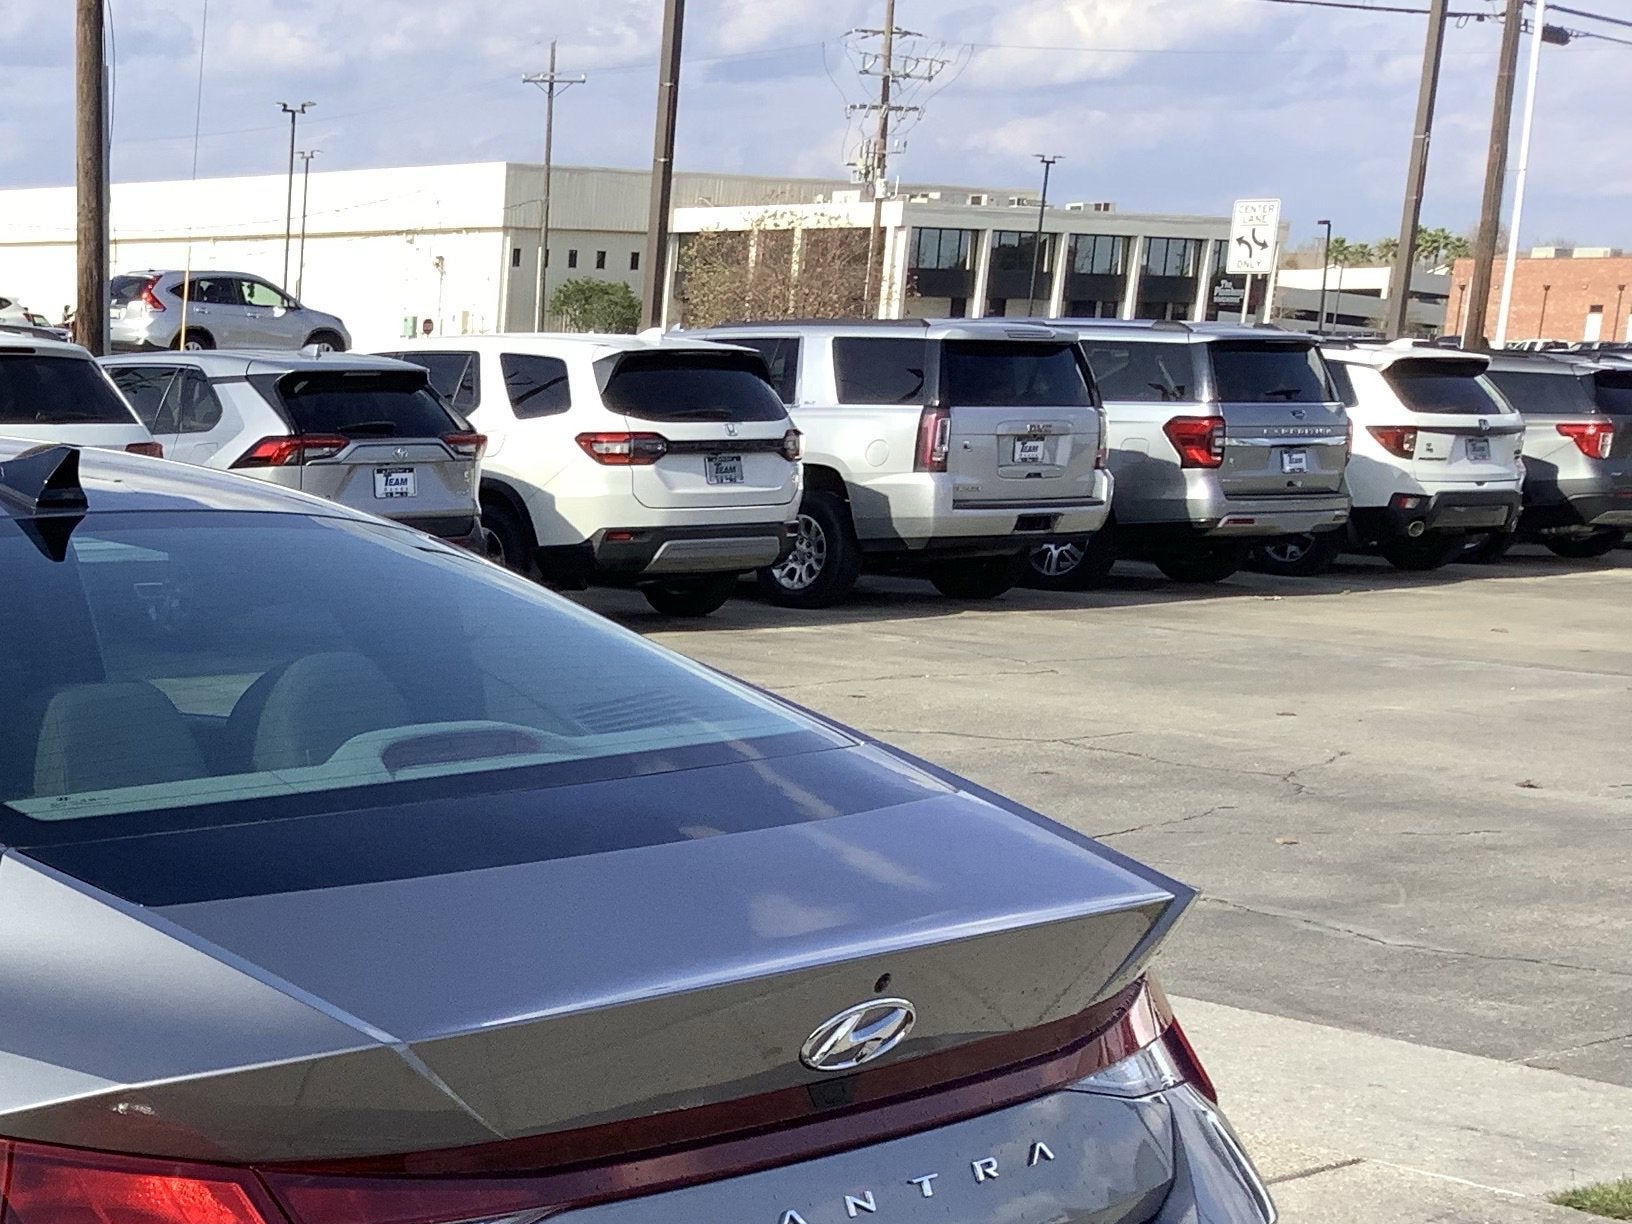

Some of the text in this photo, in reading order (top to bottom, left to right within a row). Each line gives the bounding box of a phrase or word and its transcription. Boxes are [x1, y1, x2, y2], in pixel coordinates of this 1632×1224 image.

[1238, 204, 1275, 213] CENTER
[1242, 215, 1268, 223] LANE
[1237, 260, 1262, 268] ONLY
